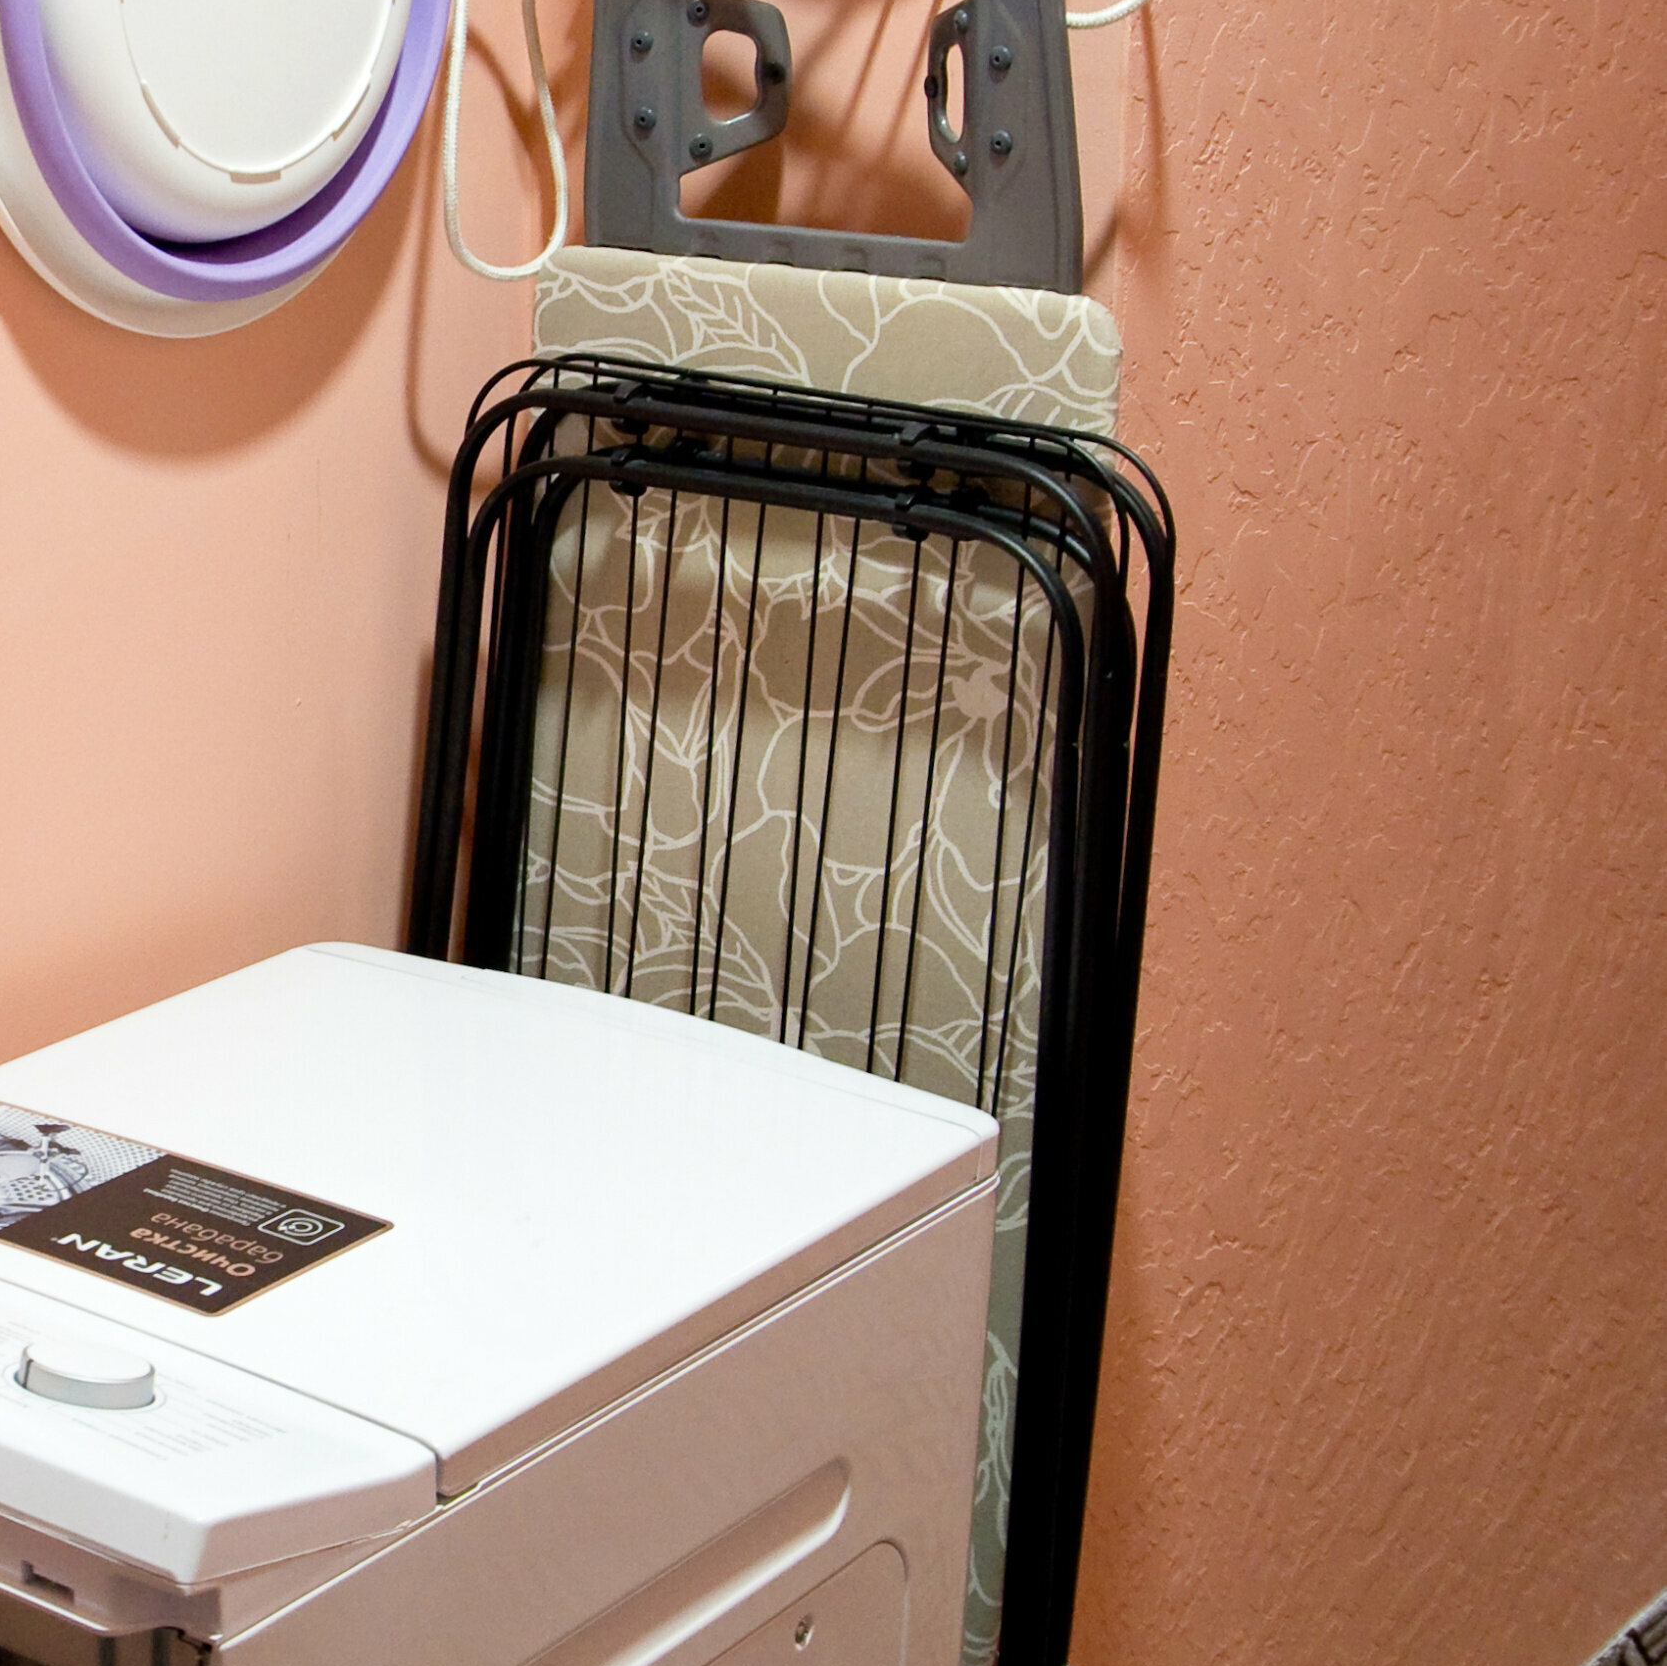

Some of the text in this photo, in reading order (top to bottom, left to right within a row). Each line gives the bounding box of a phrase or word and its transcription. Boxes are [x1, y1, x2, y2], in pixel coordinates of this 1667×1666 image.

[130, 1227, 256, 1277] Очистка
[151, 1212, 284, 1264] барабана
[57, 1233, 223, 1297] LERAN
